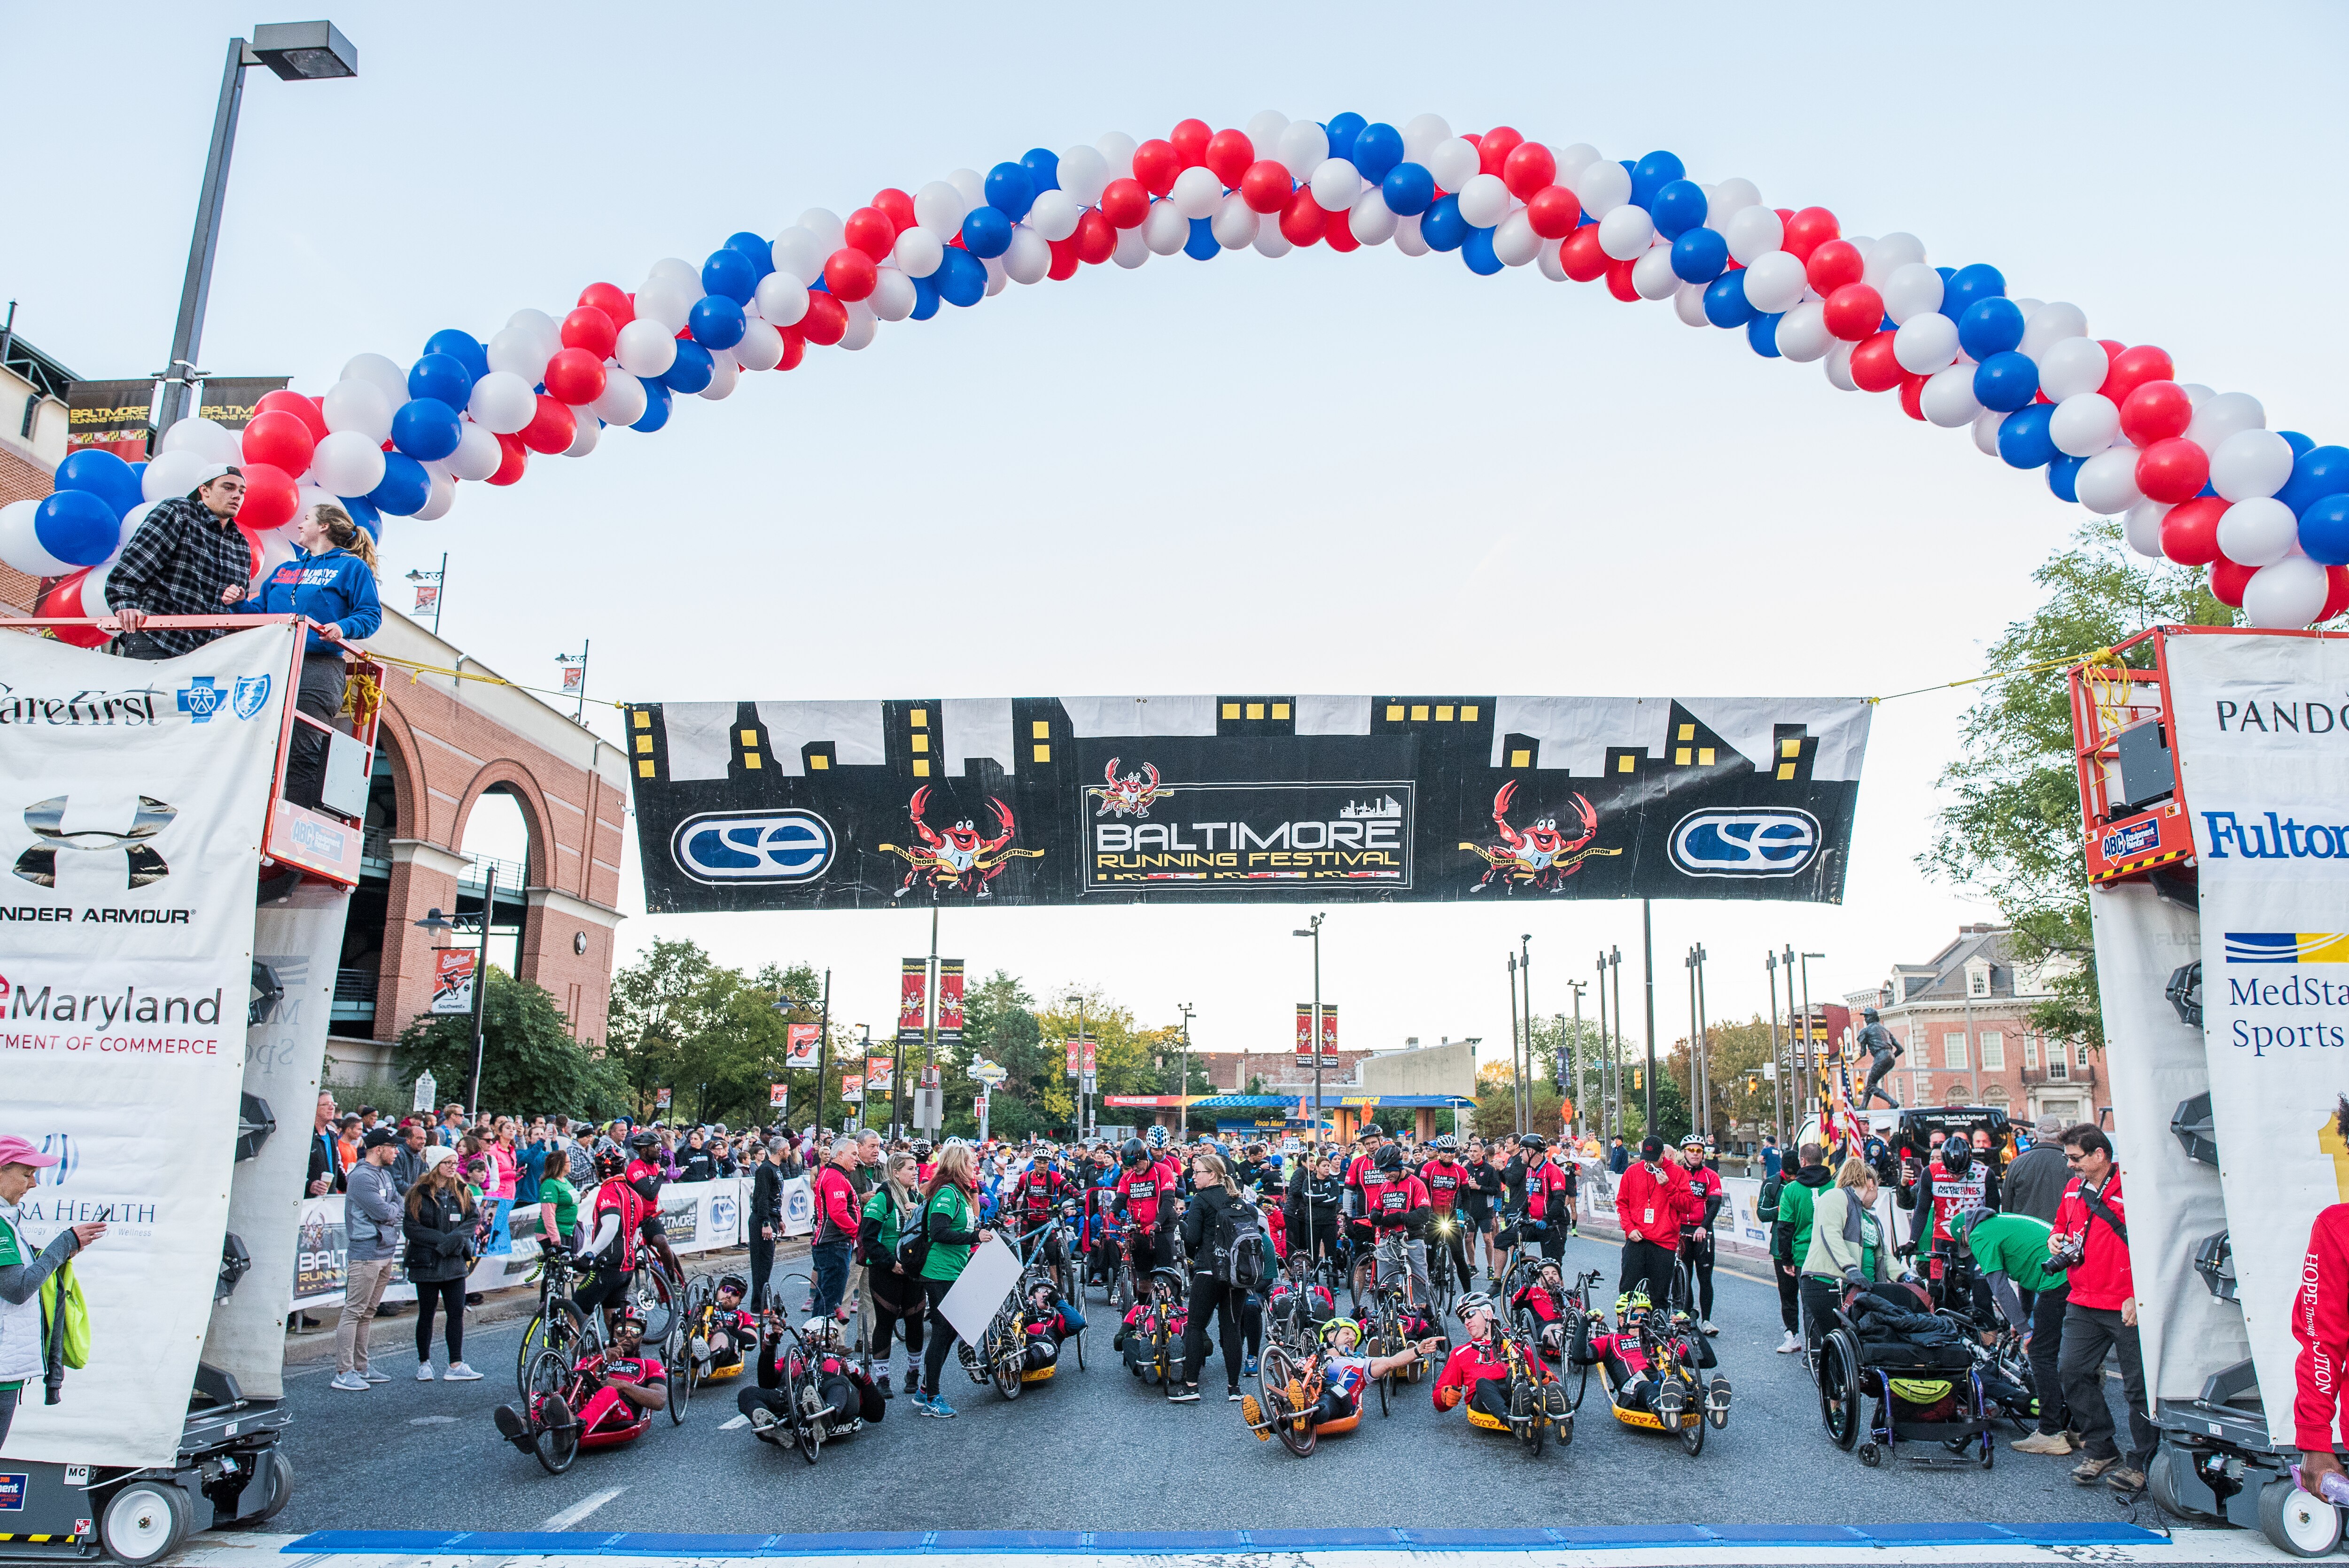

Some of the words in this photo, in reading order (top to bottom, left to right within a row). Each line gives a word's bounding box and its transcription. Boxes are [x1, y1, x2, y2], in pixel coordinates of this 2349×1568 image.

[70, 406, 150, 418] BALTIMORE
[2217, 701, 2349, 733] PAND
[293, 820, 312, 846] ABC
[316, 832, 340, 847] Equipment
[1097, 821, 1401, 851] BALTIMORE
[2126, 827, 2155, 841] Equipment
[314, 839, 331, 851] Rental
[2104, 834, 2123, 857] ABC
[2126, 838, 2145, 850] Rental
[893, 846, 937, 865] BALTIMORE
[990, 850, 1034, 865] MARATHON
[1097, 853, 1237, 868] RUNNING
[1248, 852, 1400, 866] FESTIVAL
[1472, 845, 1516, 865] BALTIMORE
[1568, 849, 1611, 865] MARATHON
[0, 907, 72, 922] NDER
[12, 986, 222, 1032] Maryland
[67, 1037, 93, 1051] OF
[100, 1037, 218, 1055] COMMERCE
[2232, 1020, 2344, 1057] Sports
[1340, 1097, 1381, 1105] SUNOCO
[55, 1199, 156, 1223] HEALTH
[299, 1268, 347, 1283] RUNNIN
[2302, 1252, 2319, 1305] HOPE
[2305, 1307, 2318, 1337] Through
[2313, 1340, 2332, 1395] CTION
[1469, 1415, 1495, 1427] force
[1619, 1412, 1648, 1424] force
[835, 1423, 852, 1434] END
[69, 1468, 86, 1476] MC
